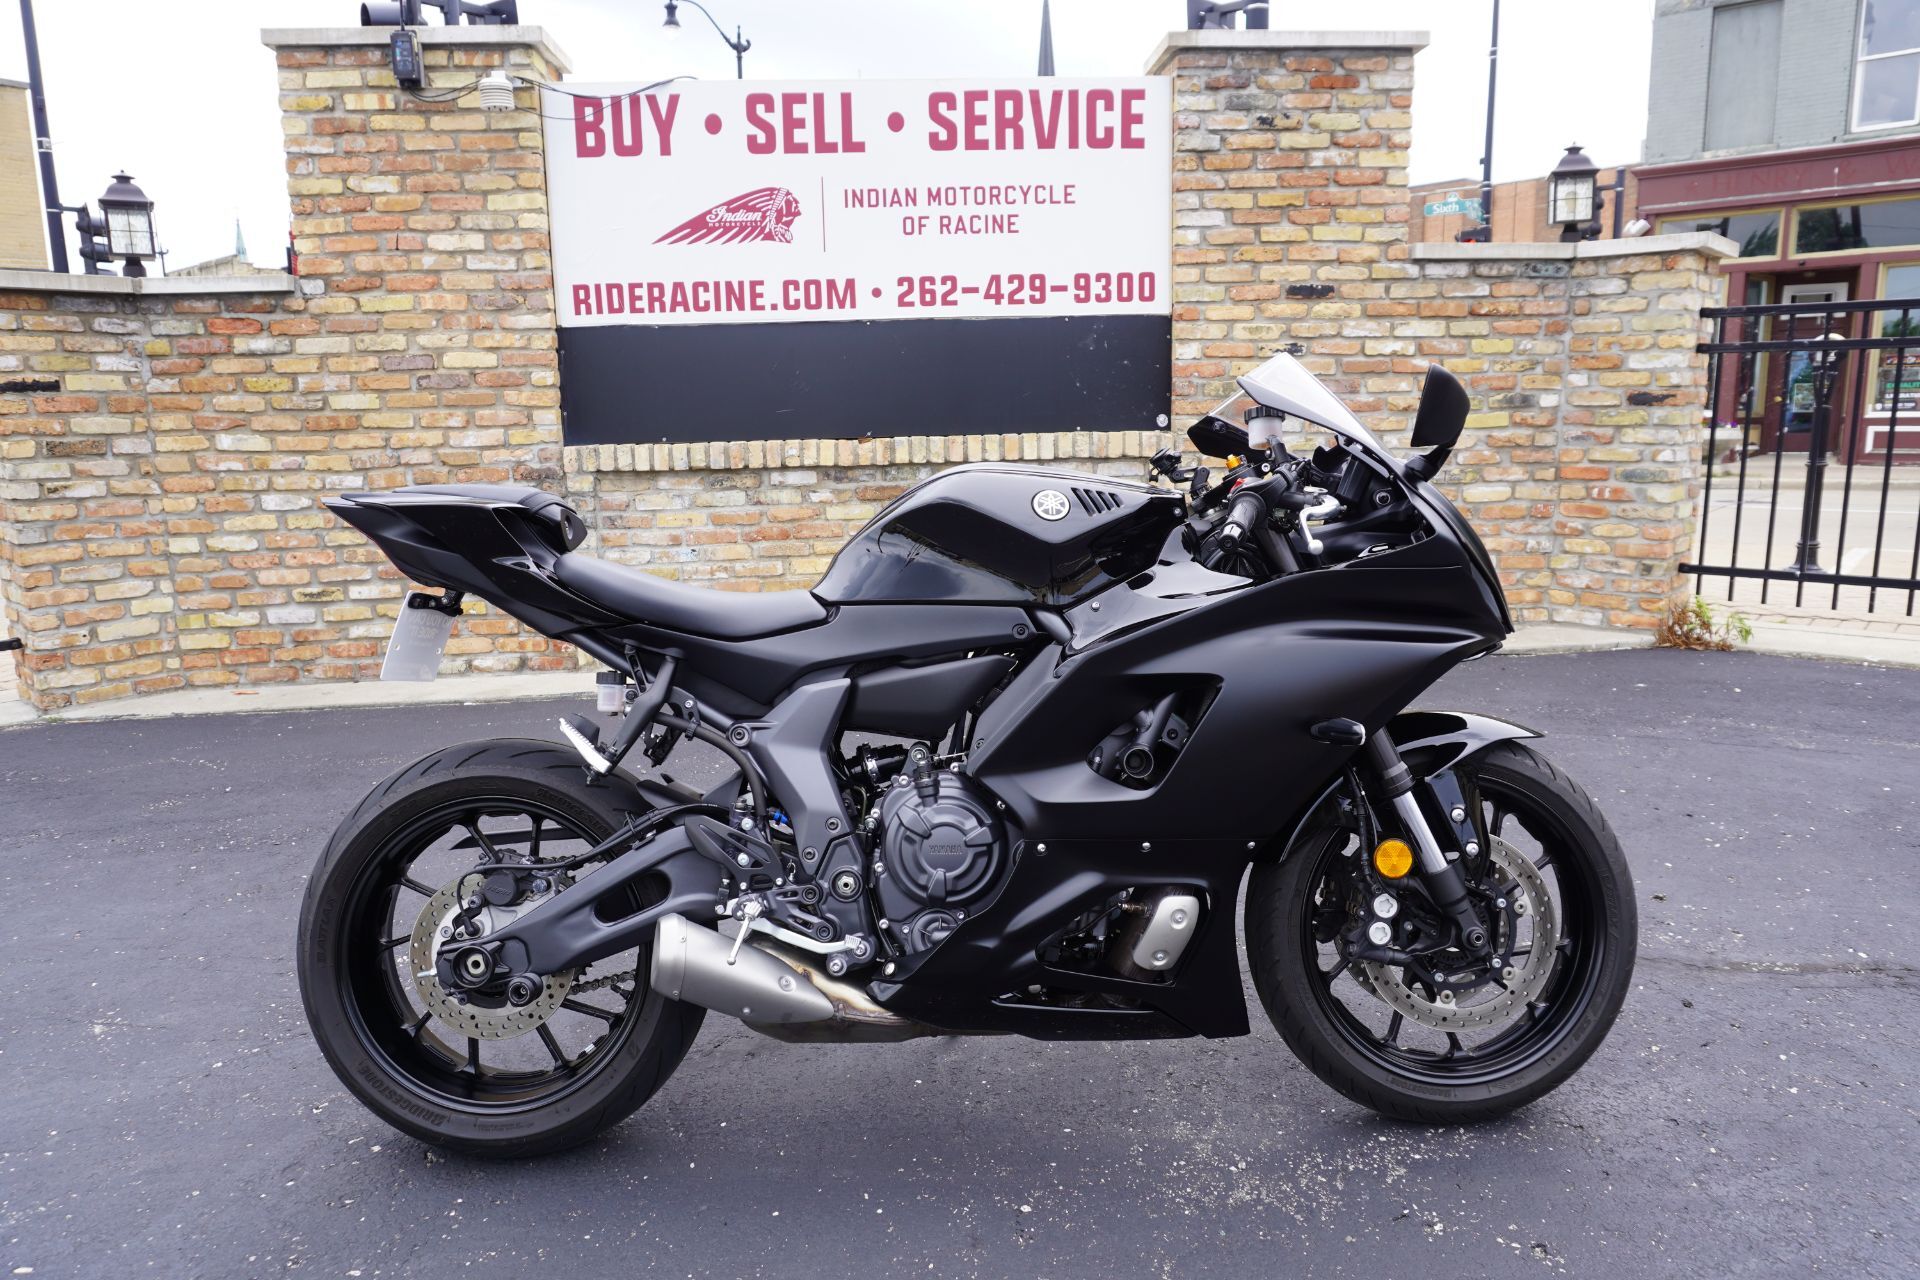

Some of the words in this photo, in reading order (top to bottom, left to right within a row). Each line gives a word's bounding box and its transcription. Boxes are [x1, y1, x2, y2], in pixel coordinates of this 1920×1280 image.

[574, 93, 680, 159] BUY
[746, 92, 866, 155] SELL
[928, 88, 1146, 152] SERVICE
[844, 187, 918, 209] INDIAN
[926, 184, 1076, 206] MOTORCYCLE
[1432, 202, 1460, 213] Sixth
[706, 206, 762, 221] Indian
[902, 215, 929, 236] OF
[939, 214, 1019, 235] RACINE
[572, 277, 857, 316] RIDERACINE.COM
[897, 271, 1156, 308] 262-429-9300
[357, 1064, 447, 1126] BRIDGESTONE
